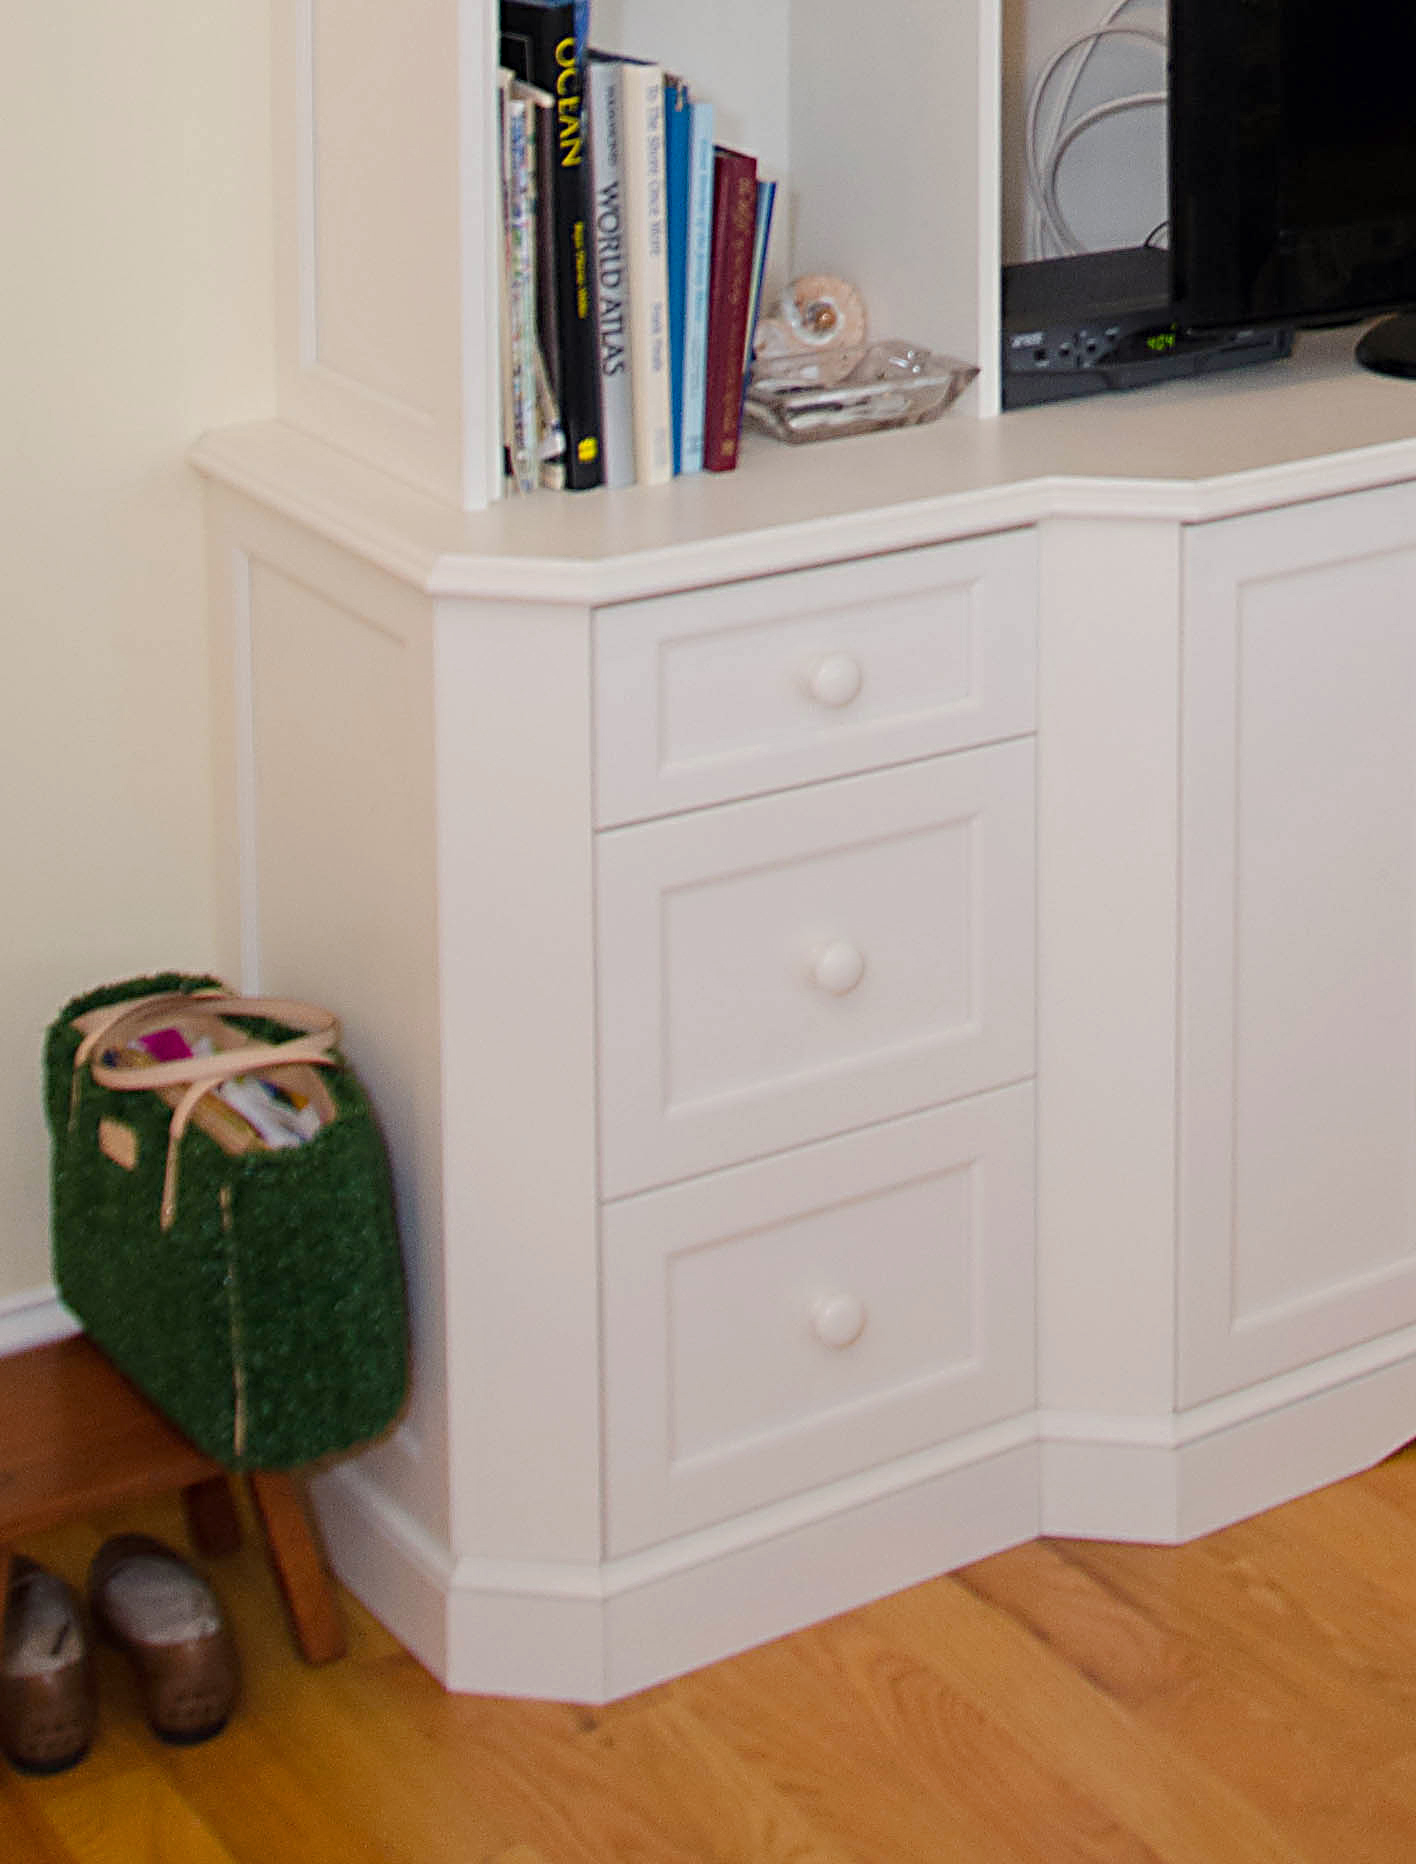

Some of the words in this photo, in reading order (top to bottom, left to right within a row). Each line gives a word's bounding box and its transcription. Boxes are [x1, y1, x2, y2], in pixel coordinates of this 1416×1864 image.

[555, 37, 583, 168] OCEAN
[647, 106, 659, 130] The
[596, 186, 623, 289] WORLD
[600, 294, 626, 377] ATLAS
